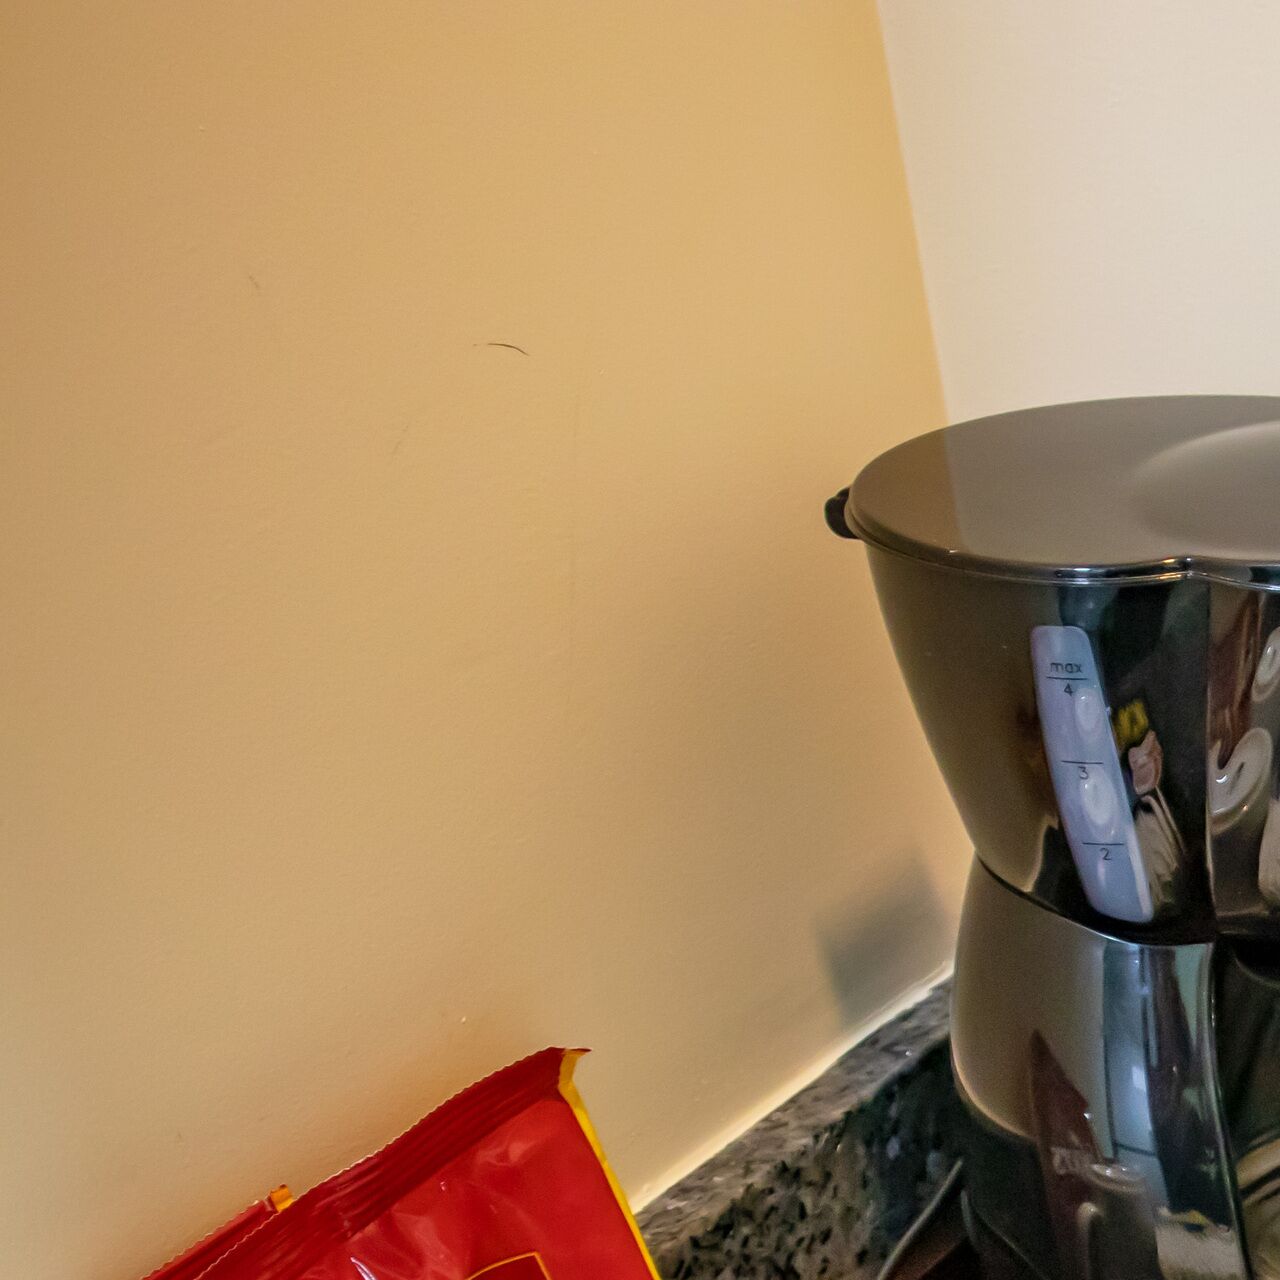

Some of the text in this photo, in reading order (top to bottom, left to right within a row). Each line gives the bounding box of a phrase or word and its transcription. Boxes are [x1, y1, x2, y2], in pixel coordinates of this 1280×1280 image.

[1051, 662, 1082, 673] max
[1063, 684, 1073, 696] 4
[1078, 766, 1089, 780] 3
[1100, 848, 1111, 860] 2
